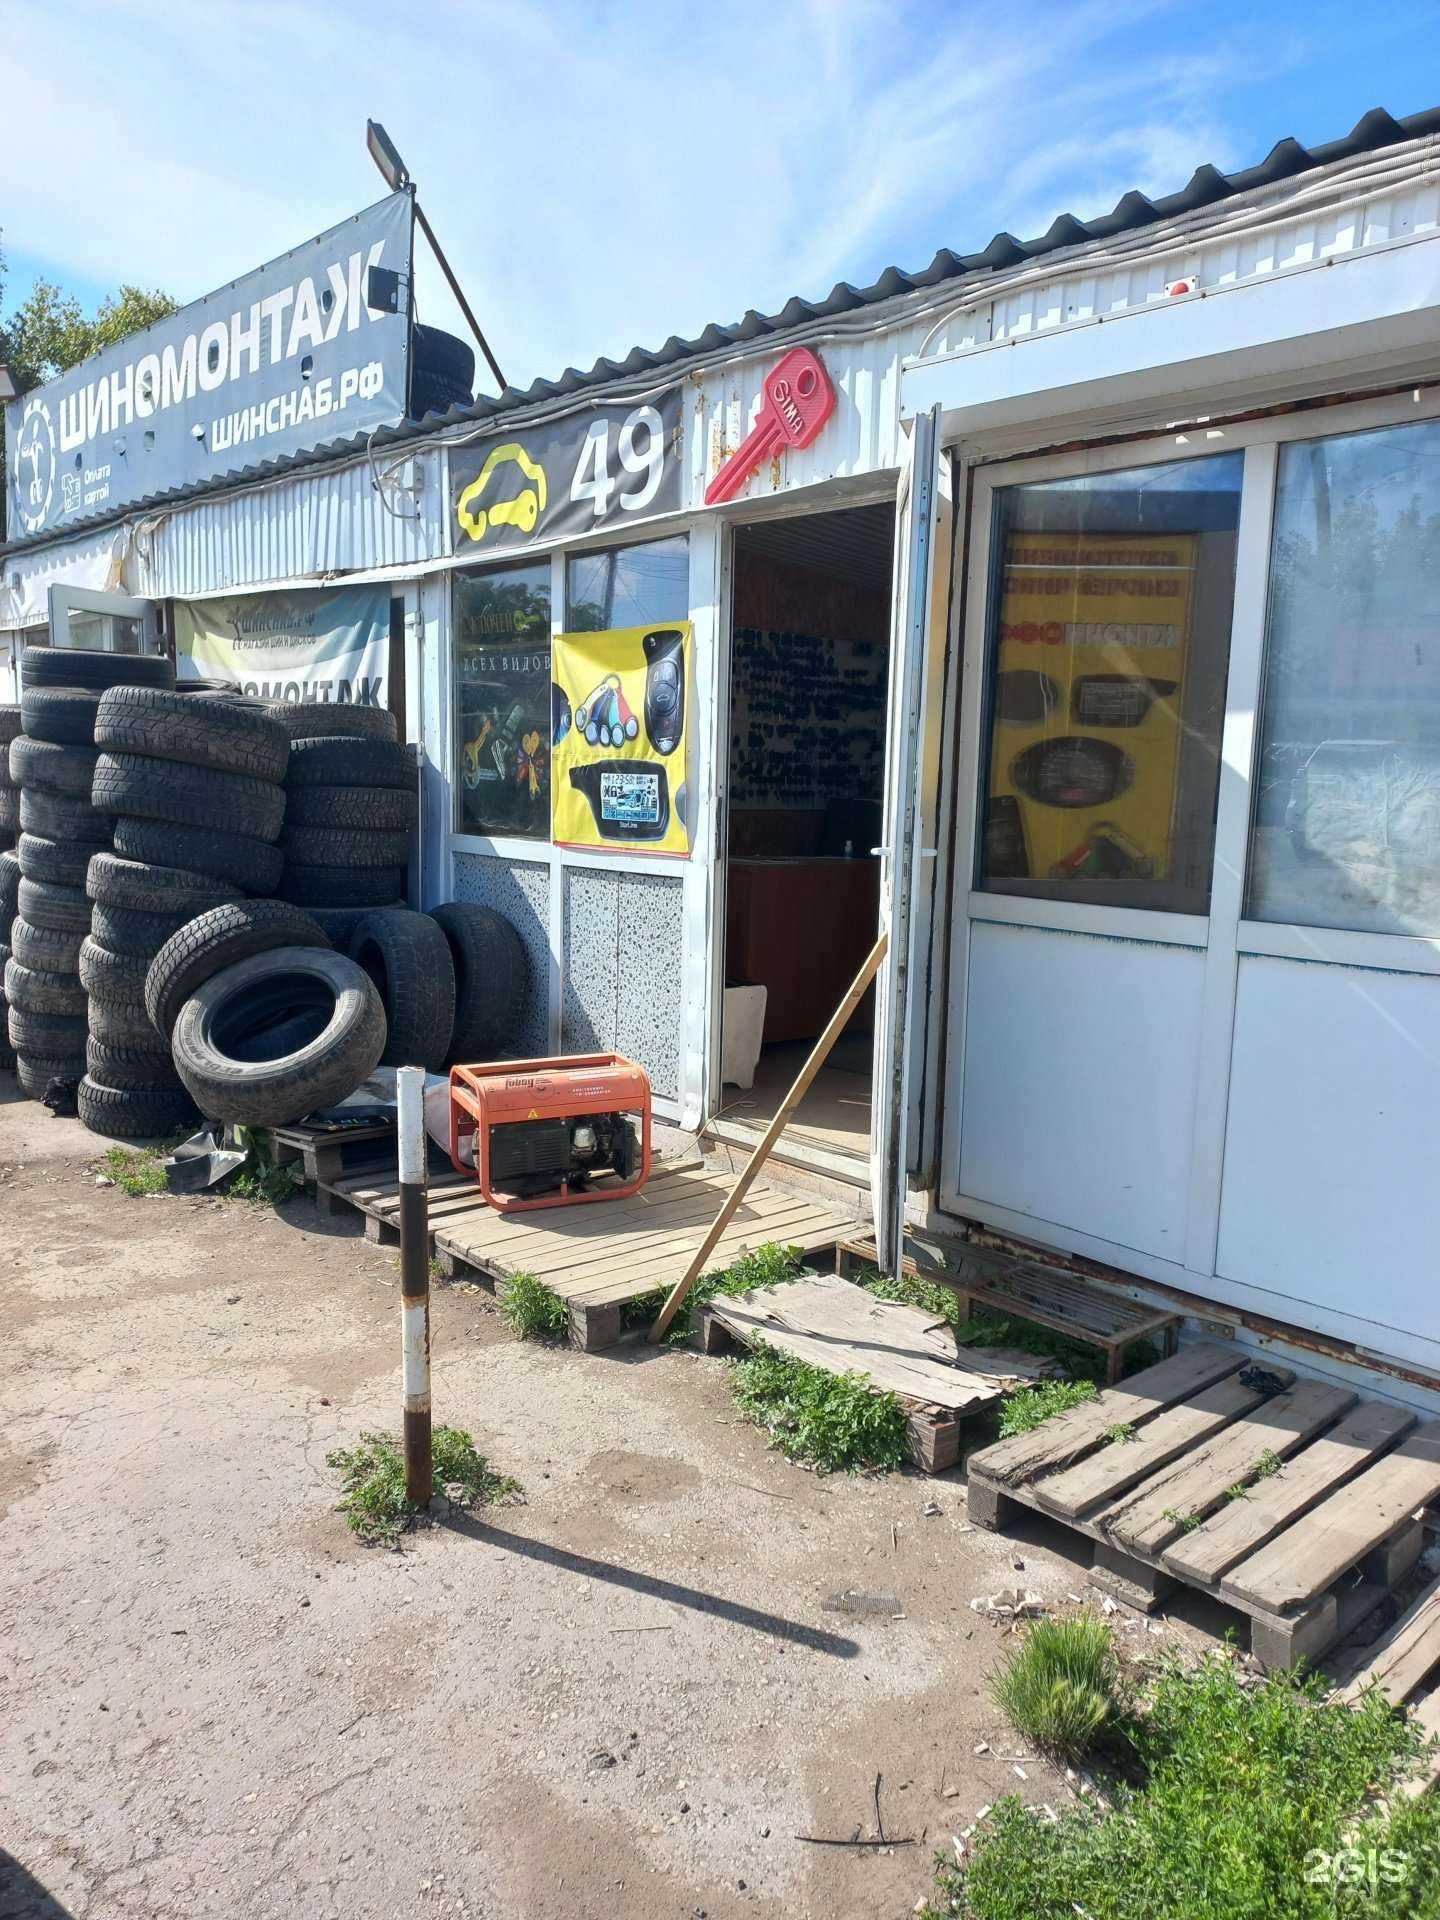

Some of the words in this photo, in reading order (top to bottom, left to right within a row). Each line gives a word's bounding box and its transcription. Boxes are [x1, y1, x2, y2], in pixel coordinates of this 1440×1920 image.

[59, 240, 386, 453] ШИНОМОНТАЖ
[211, 360, 384, 453] ШИНСНАБ.РФ
[774, 380, 803, 434] SIMA
[84, 464, 111, 485] Оплата
[569, 405, 664, 516] 49
[502, 656, 551, 671] ВИДОВ
